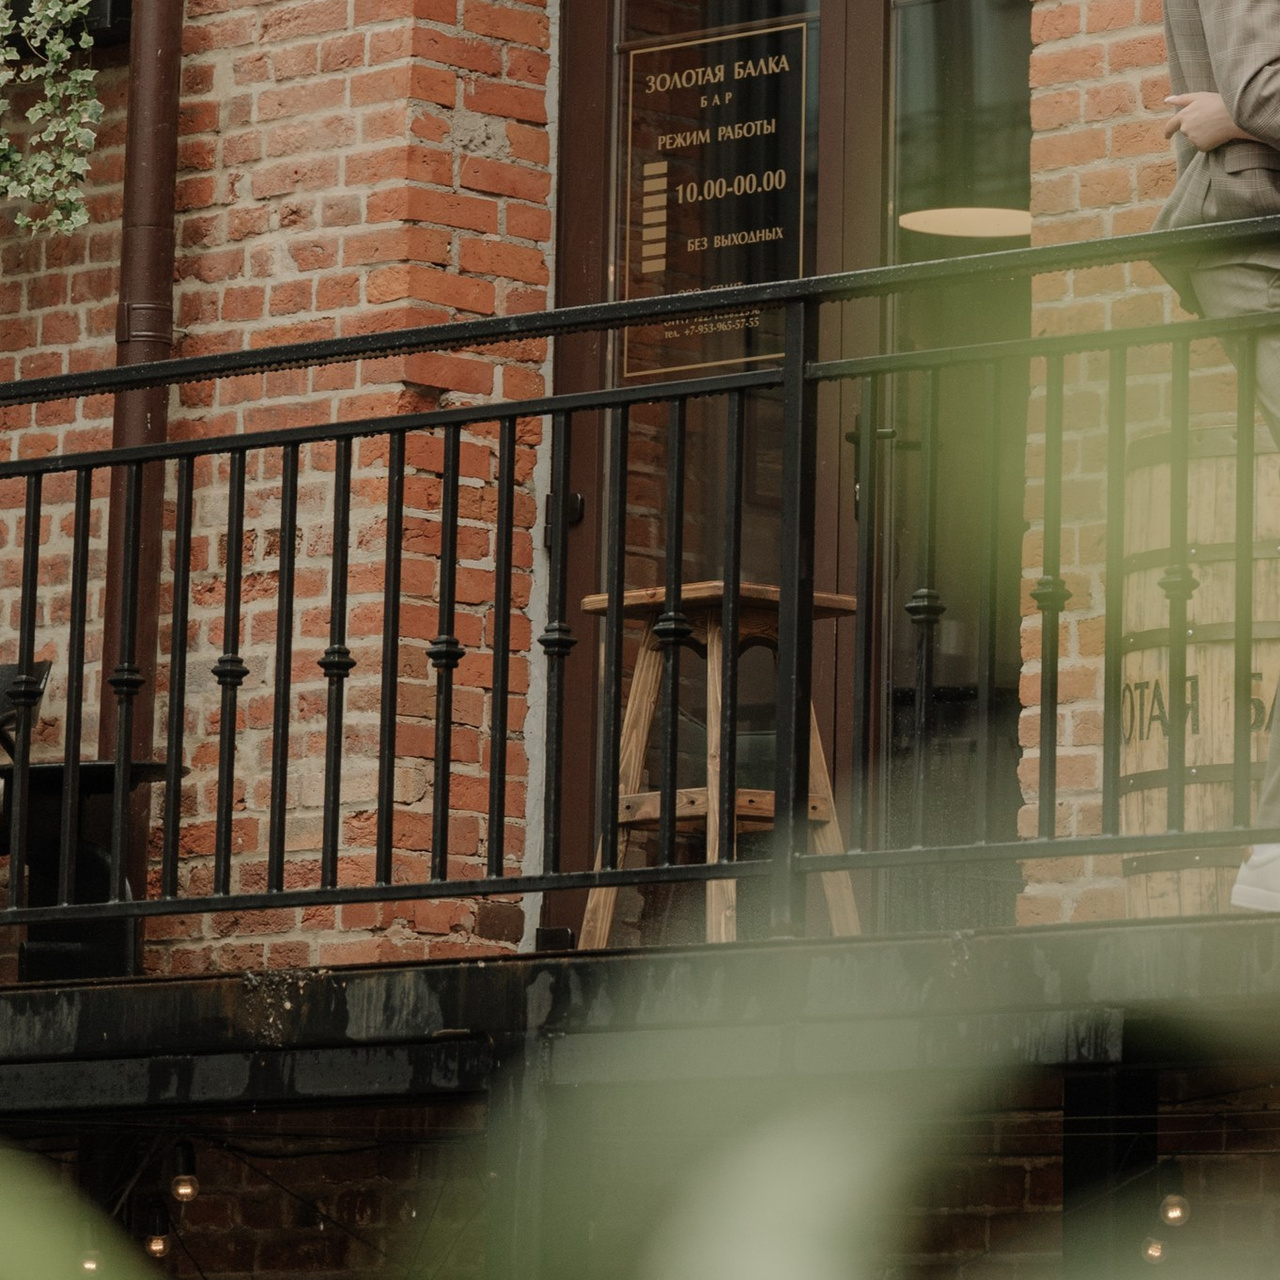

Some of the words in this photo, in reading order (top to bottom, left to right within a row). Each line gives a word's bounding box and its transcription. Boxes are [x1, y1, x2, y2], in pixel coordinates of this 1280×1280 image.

[645, 64, 725, 94] ЗОЛОТАЯ
[734, 54, 790, 80] БАЛКА
[700, 92, 734, 108] БАР
[658, 129, 711, 151] РЕЖИМ
[717, 119, 776, 142] РАБОТЫ
[675, 169, 787, 204] 10.00-00.00
[687, 236, 708, 252] БЕЗ
[714, 226, 784, 249] ВЫХОДНЫХ
